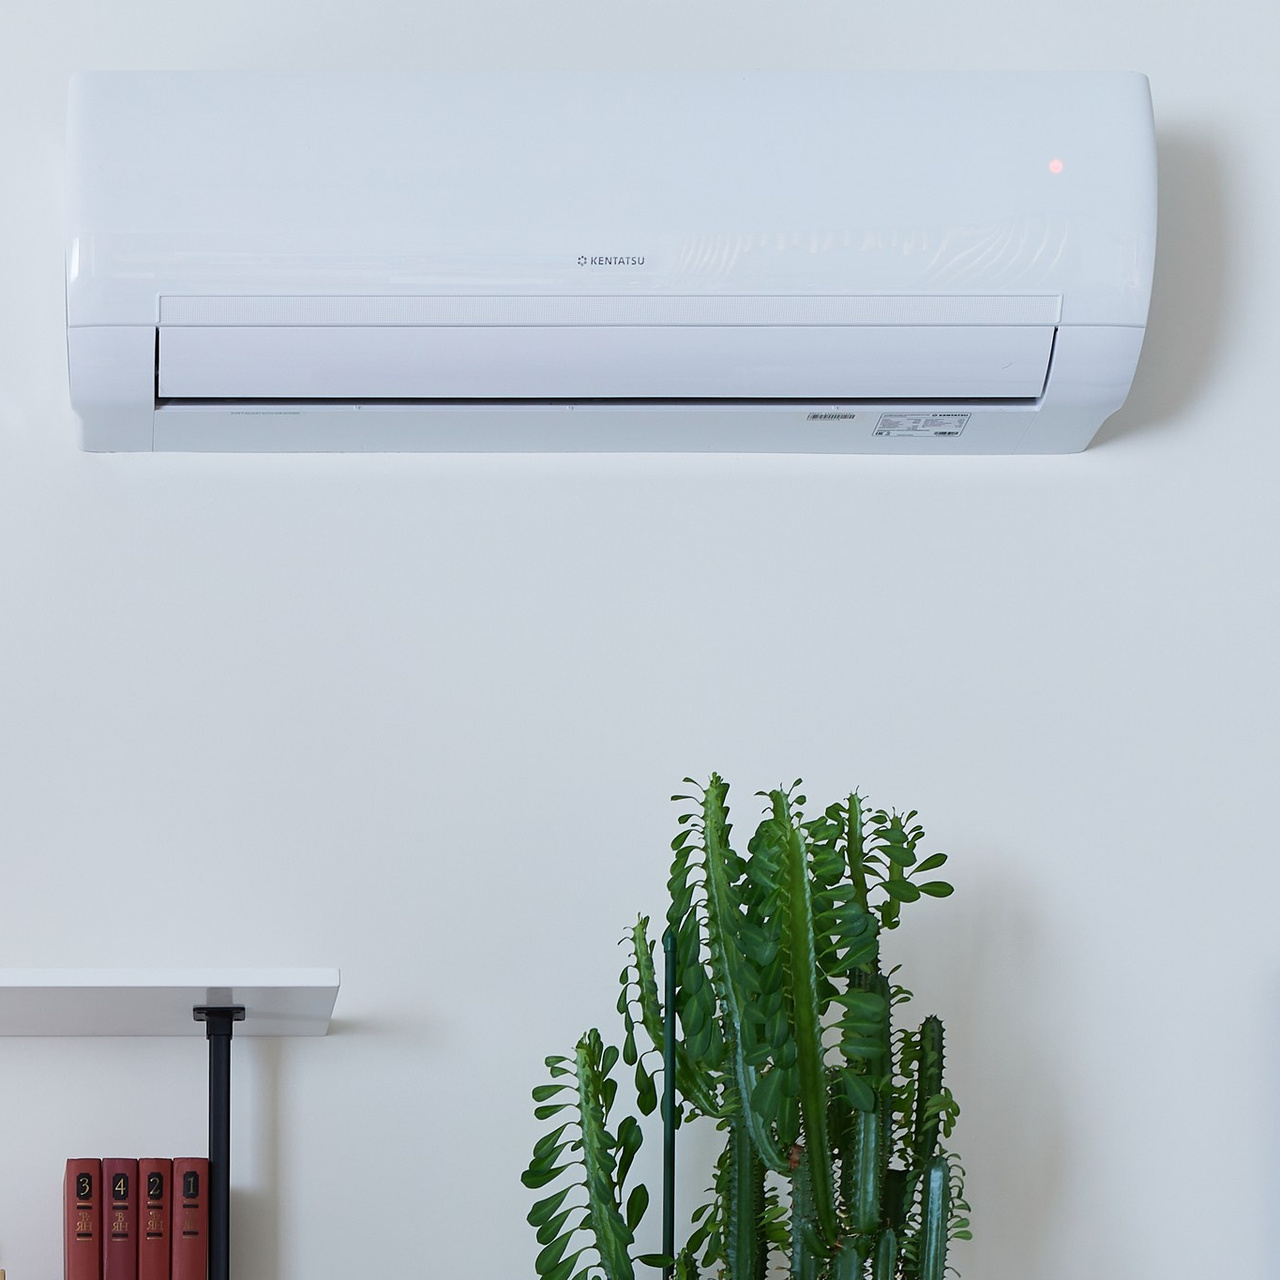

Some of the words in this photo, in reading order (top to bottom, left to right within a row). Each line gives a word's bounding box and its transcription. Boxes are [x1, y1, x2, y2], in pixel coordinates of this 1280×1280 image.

[590, 256, 645, 266] KENTATSU
[79, 1177, 90, 1196] 3
[115, 1178, 126, 1196] 4
[150, 1177, 160, 1195] 2
[188, 1177, 196, 1194] 1
[115, 1212, 125, 1222] В
[76, 1222, 92, 1232] ЯН
[112, 1222, 129, 1232] ЯН
[147, 1221, 163, 1231] ЯН
